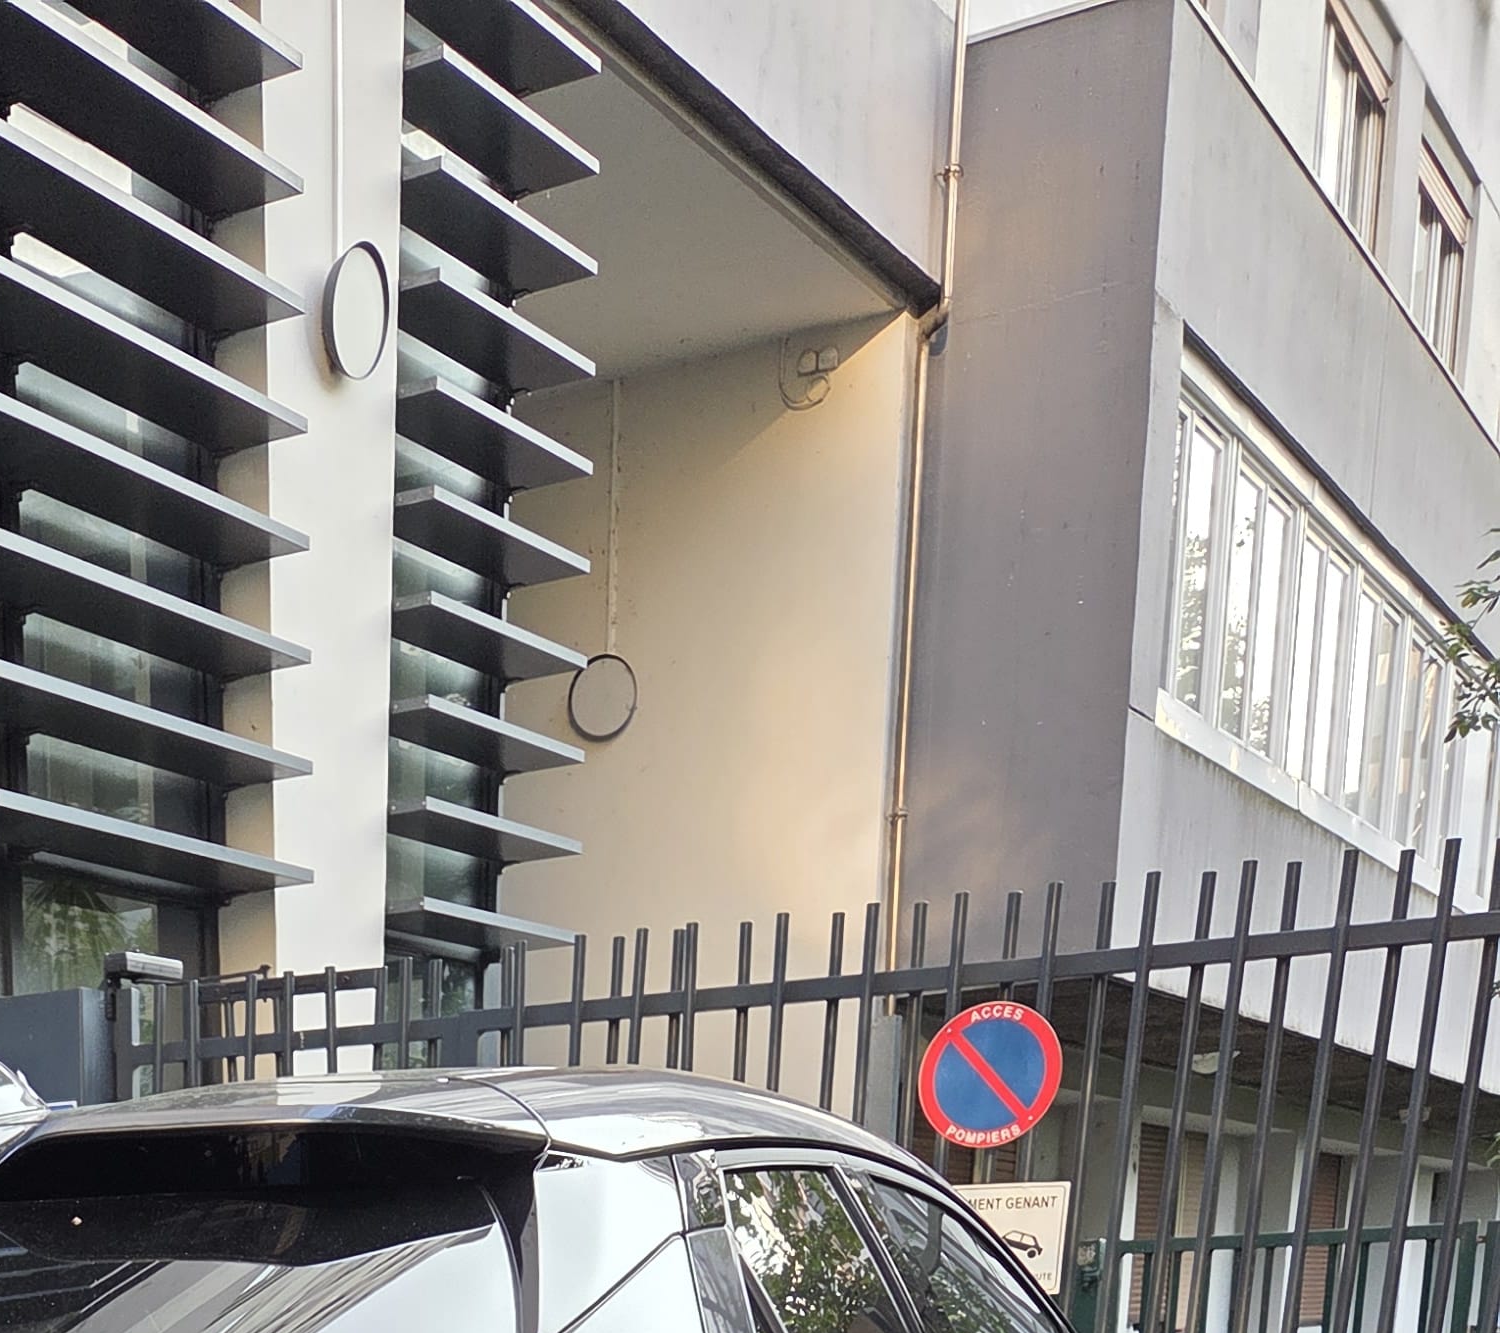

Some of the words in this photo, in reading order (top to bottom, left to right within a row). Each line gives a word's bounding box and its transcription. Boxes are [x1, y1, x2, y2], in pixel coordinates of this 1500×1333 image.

[970, 1004, 1025, 1023] ACCES
[945, 1123, 1022, 1145] POMPIERS
[1005, 1195, 1059, 1210] GENANT
